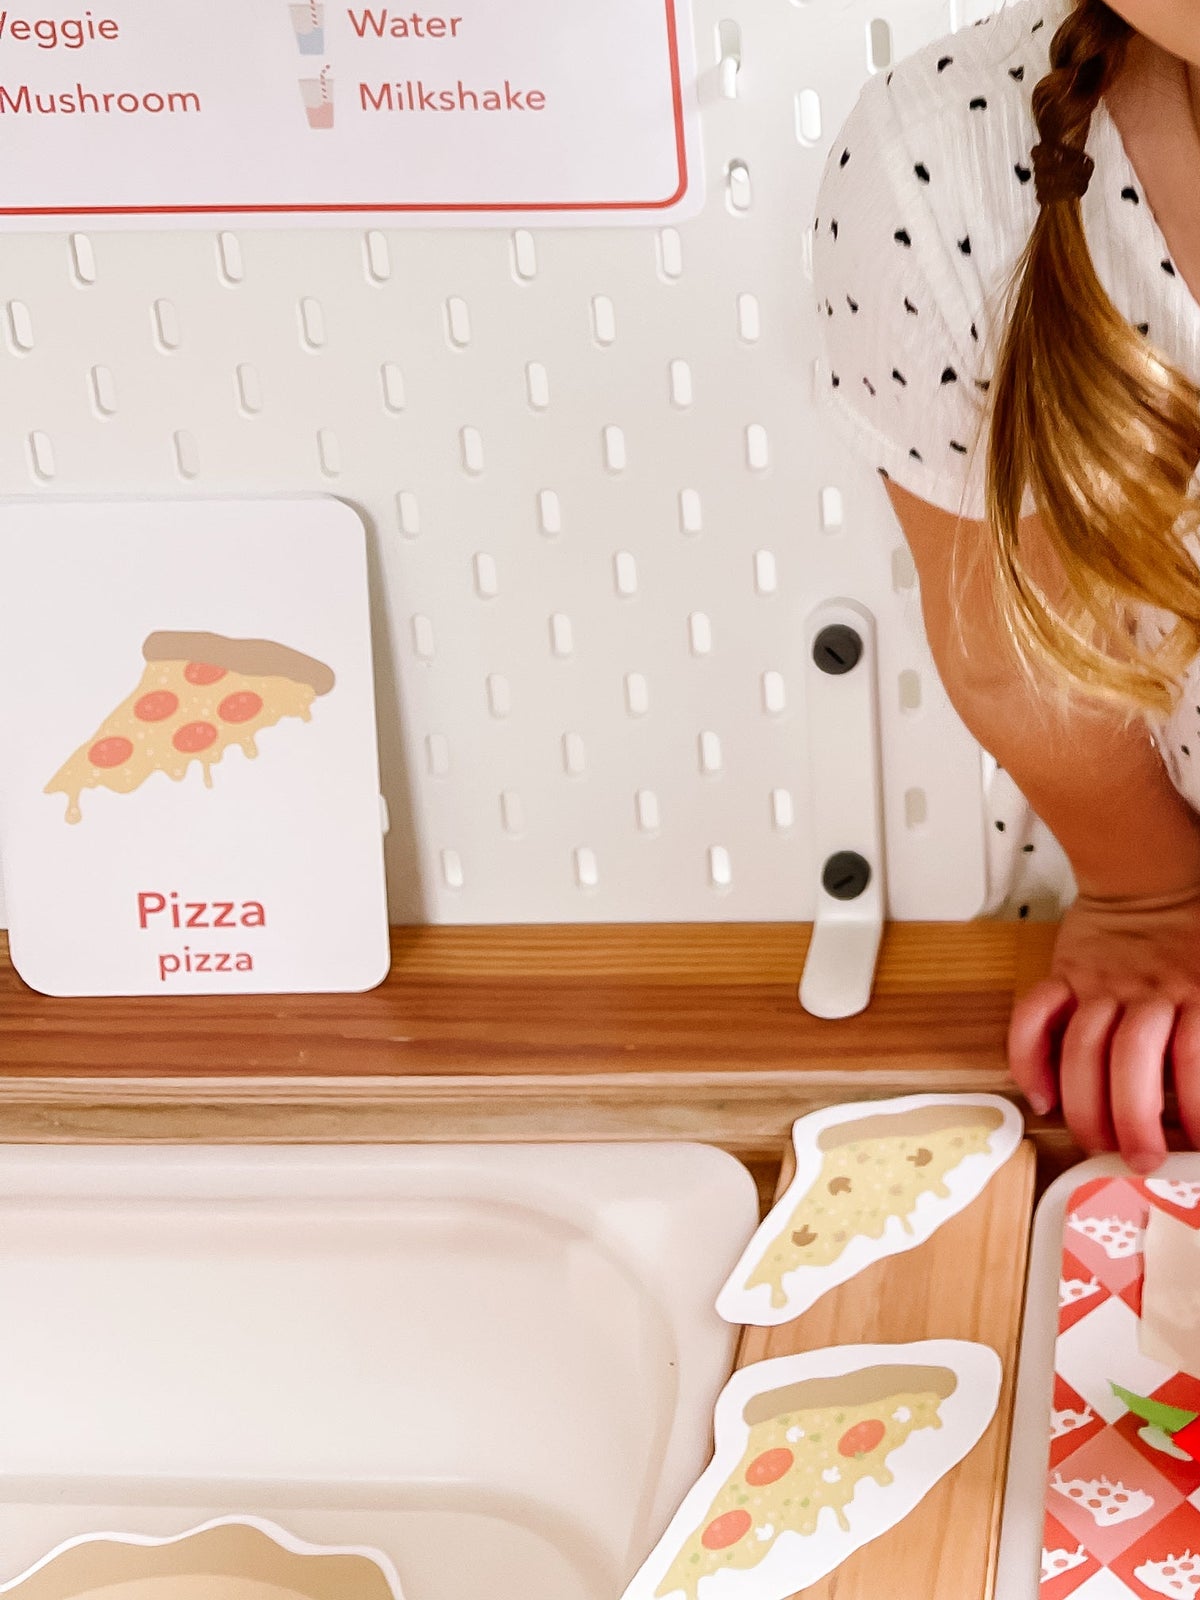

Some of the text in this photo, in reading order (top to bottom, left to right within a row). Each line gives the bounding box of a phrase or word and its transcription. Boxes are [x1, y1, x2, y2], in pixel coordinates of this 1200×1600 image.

[347, 8, 462, 38] Water
[0, 83, 201, 114] Mushroom
[358, 81, 546, 111] Milkshake
[137, 891, 267, 929] Pizza
[158, 945, 254, 982] pizza
